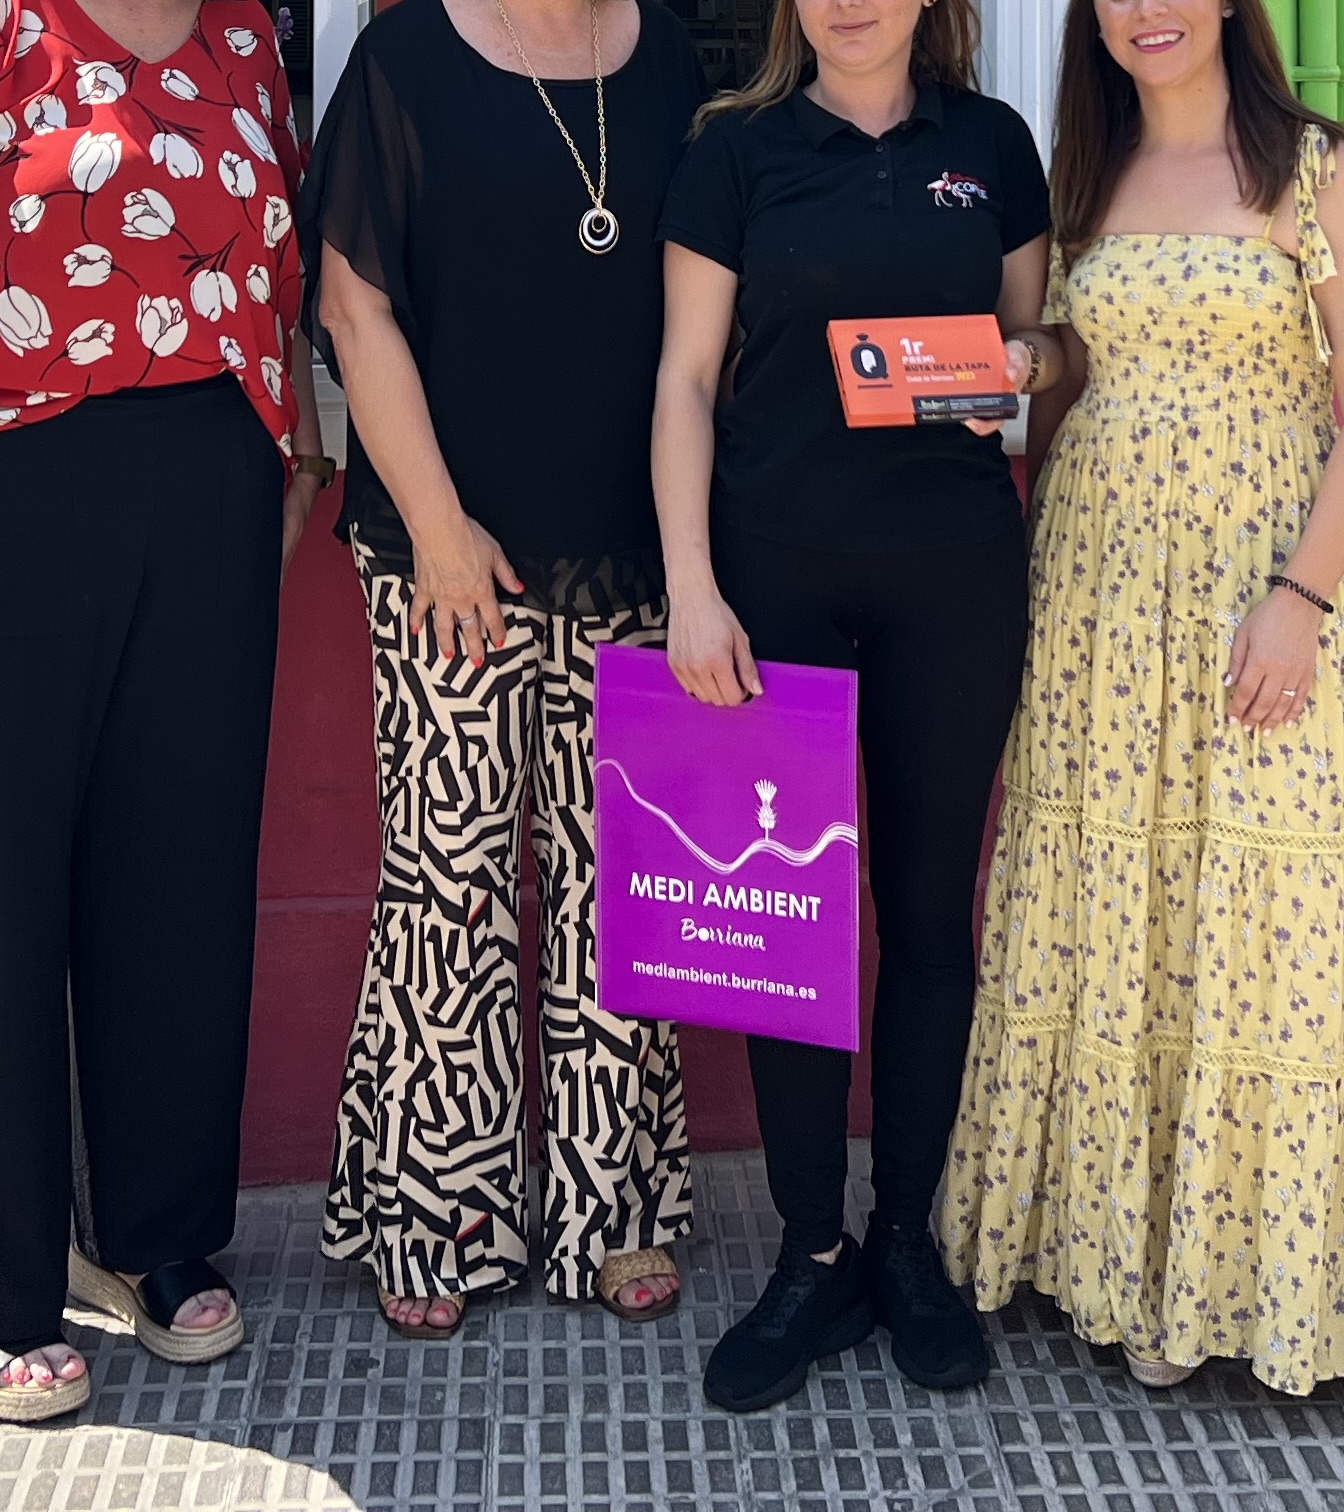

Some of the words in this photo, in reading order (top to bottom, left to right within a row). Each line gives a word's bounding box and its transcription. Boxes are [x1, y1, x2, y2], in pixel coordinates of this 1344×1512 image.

[899, 337, 924, 356] 1r
[948, 362, 963, 371] LA
[964, 361, 991, 370] TAPA
[629, 871, 694, 905] MEDI
[702, 883, 821, 922] AMBIENT
[680, 917, 766, 951] Borriana
[632, 960, 818, 1001] mediambient.burriana.es
